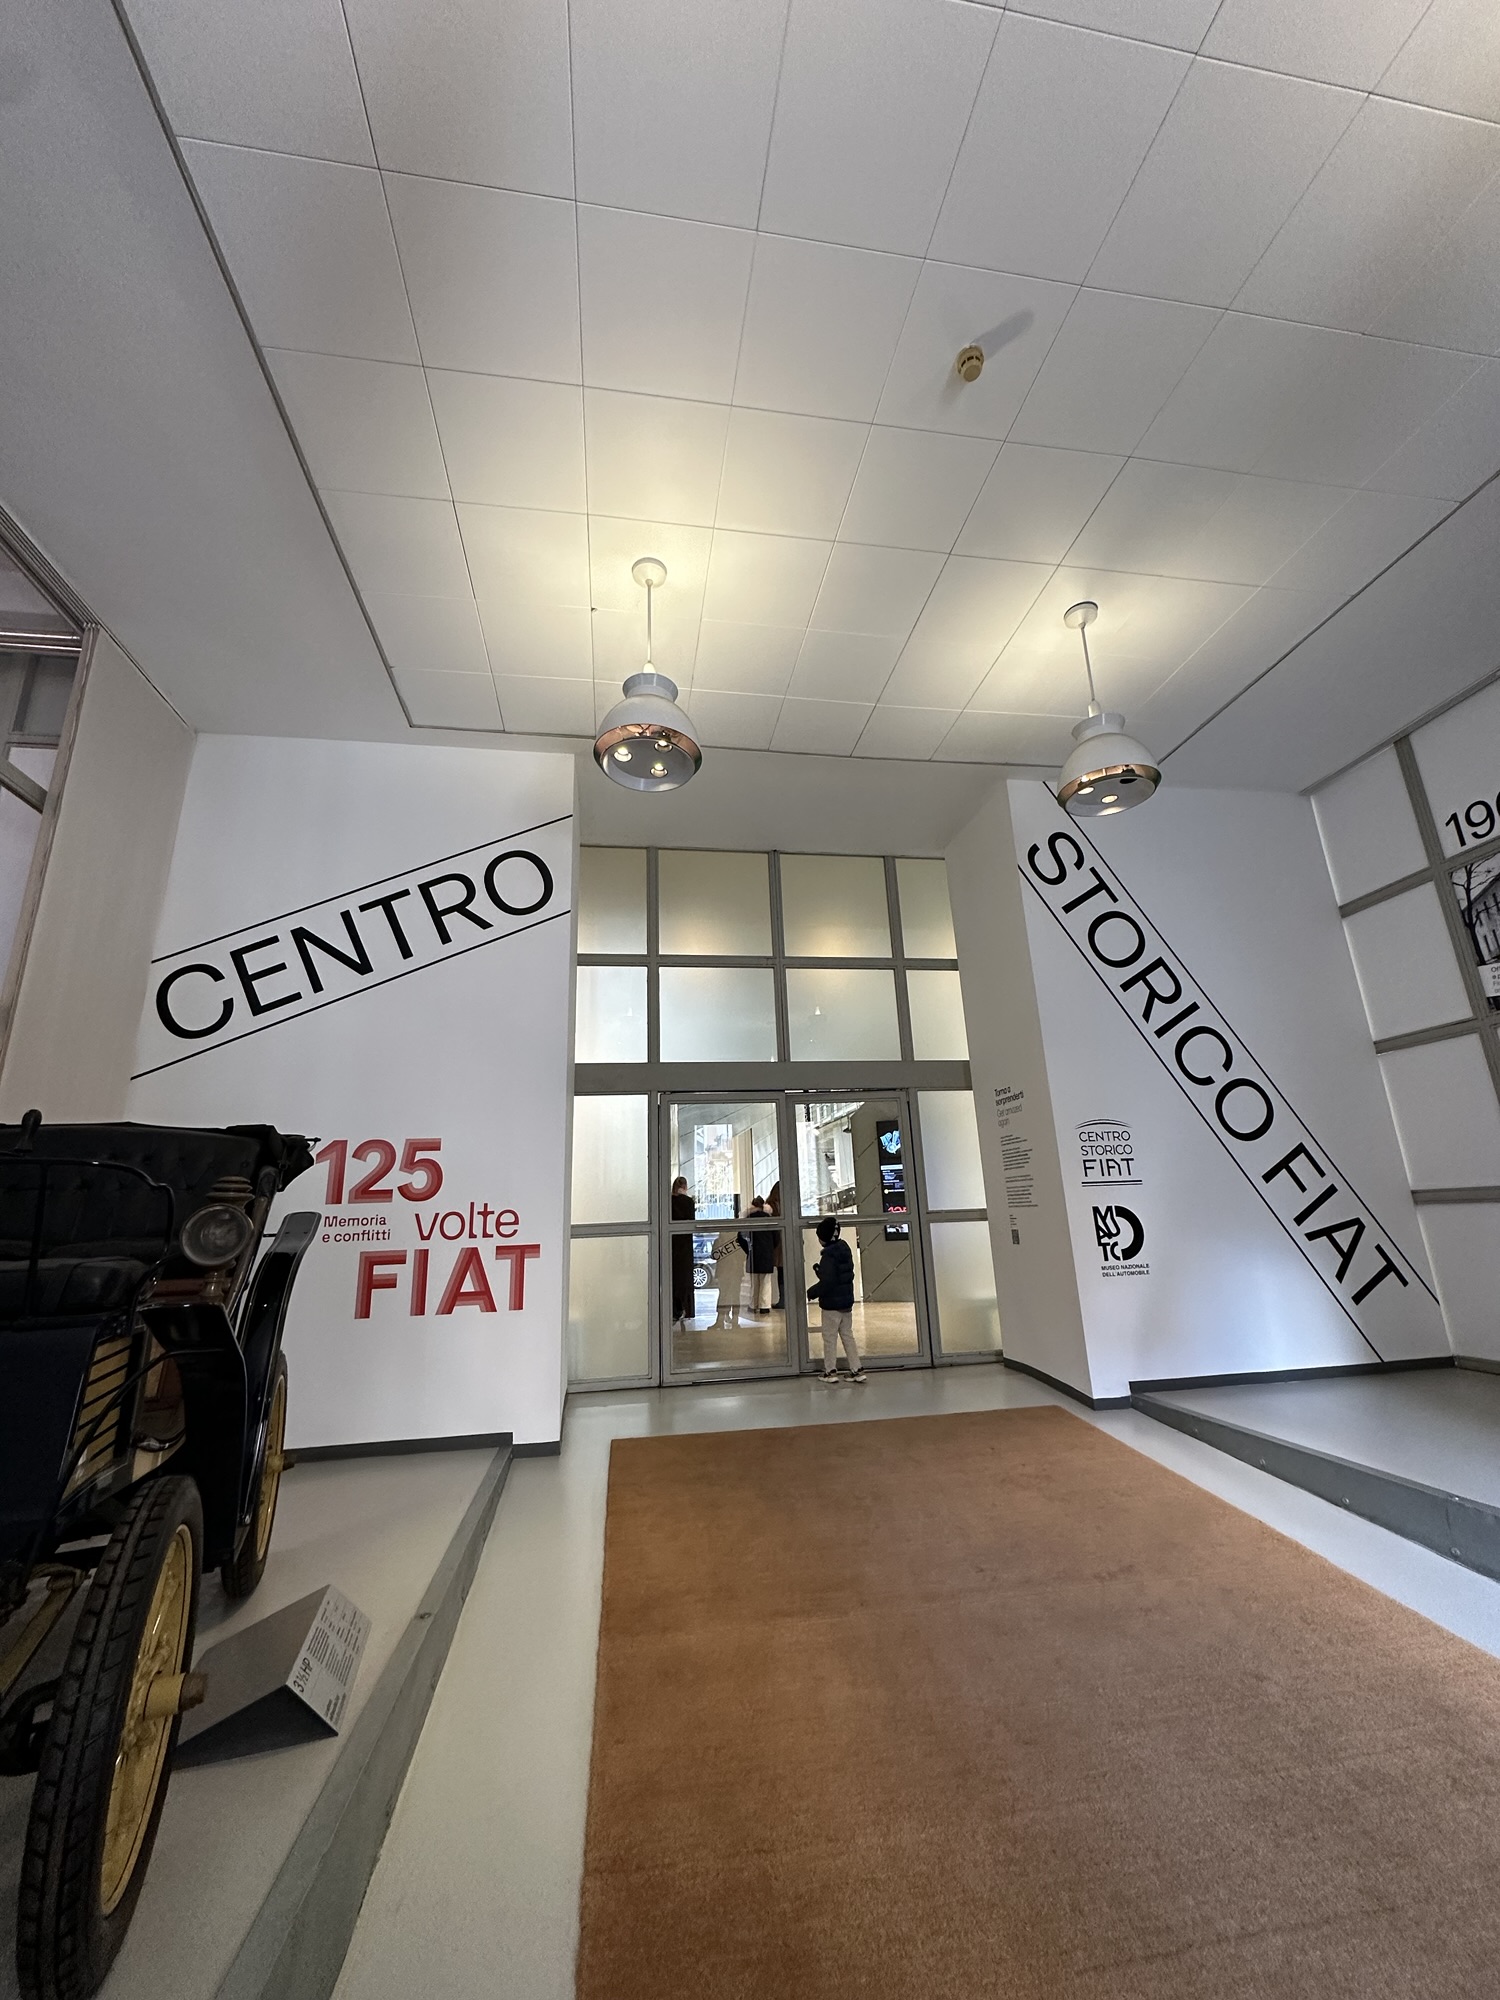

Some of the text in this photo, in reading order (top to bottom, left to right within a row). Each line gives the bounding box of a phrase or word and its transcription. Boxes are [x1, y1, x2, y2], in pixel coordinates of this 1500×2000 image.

[1445, 791, 1500, 847] 19
[155, 849, 554, 1040] CENTRO
[1027, 831, 1409, 1306] STORICO FIAT
[1079, 1130, 1131, 1142] CENTRO
[1080, 1144, 1133, 1156] STORICO
[315, 1138, 443, 1205] 125
[1083, 1158, 1134, 1177] FIAT
[322, 1229, 391, 1243] e conflitti
[324, 1214, 387, 1228] Memoria
[415, 1202, 520, 1241] volte
[354, 1244, 541, 1319] FIAT
